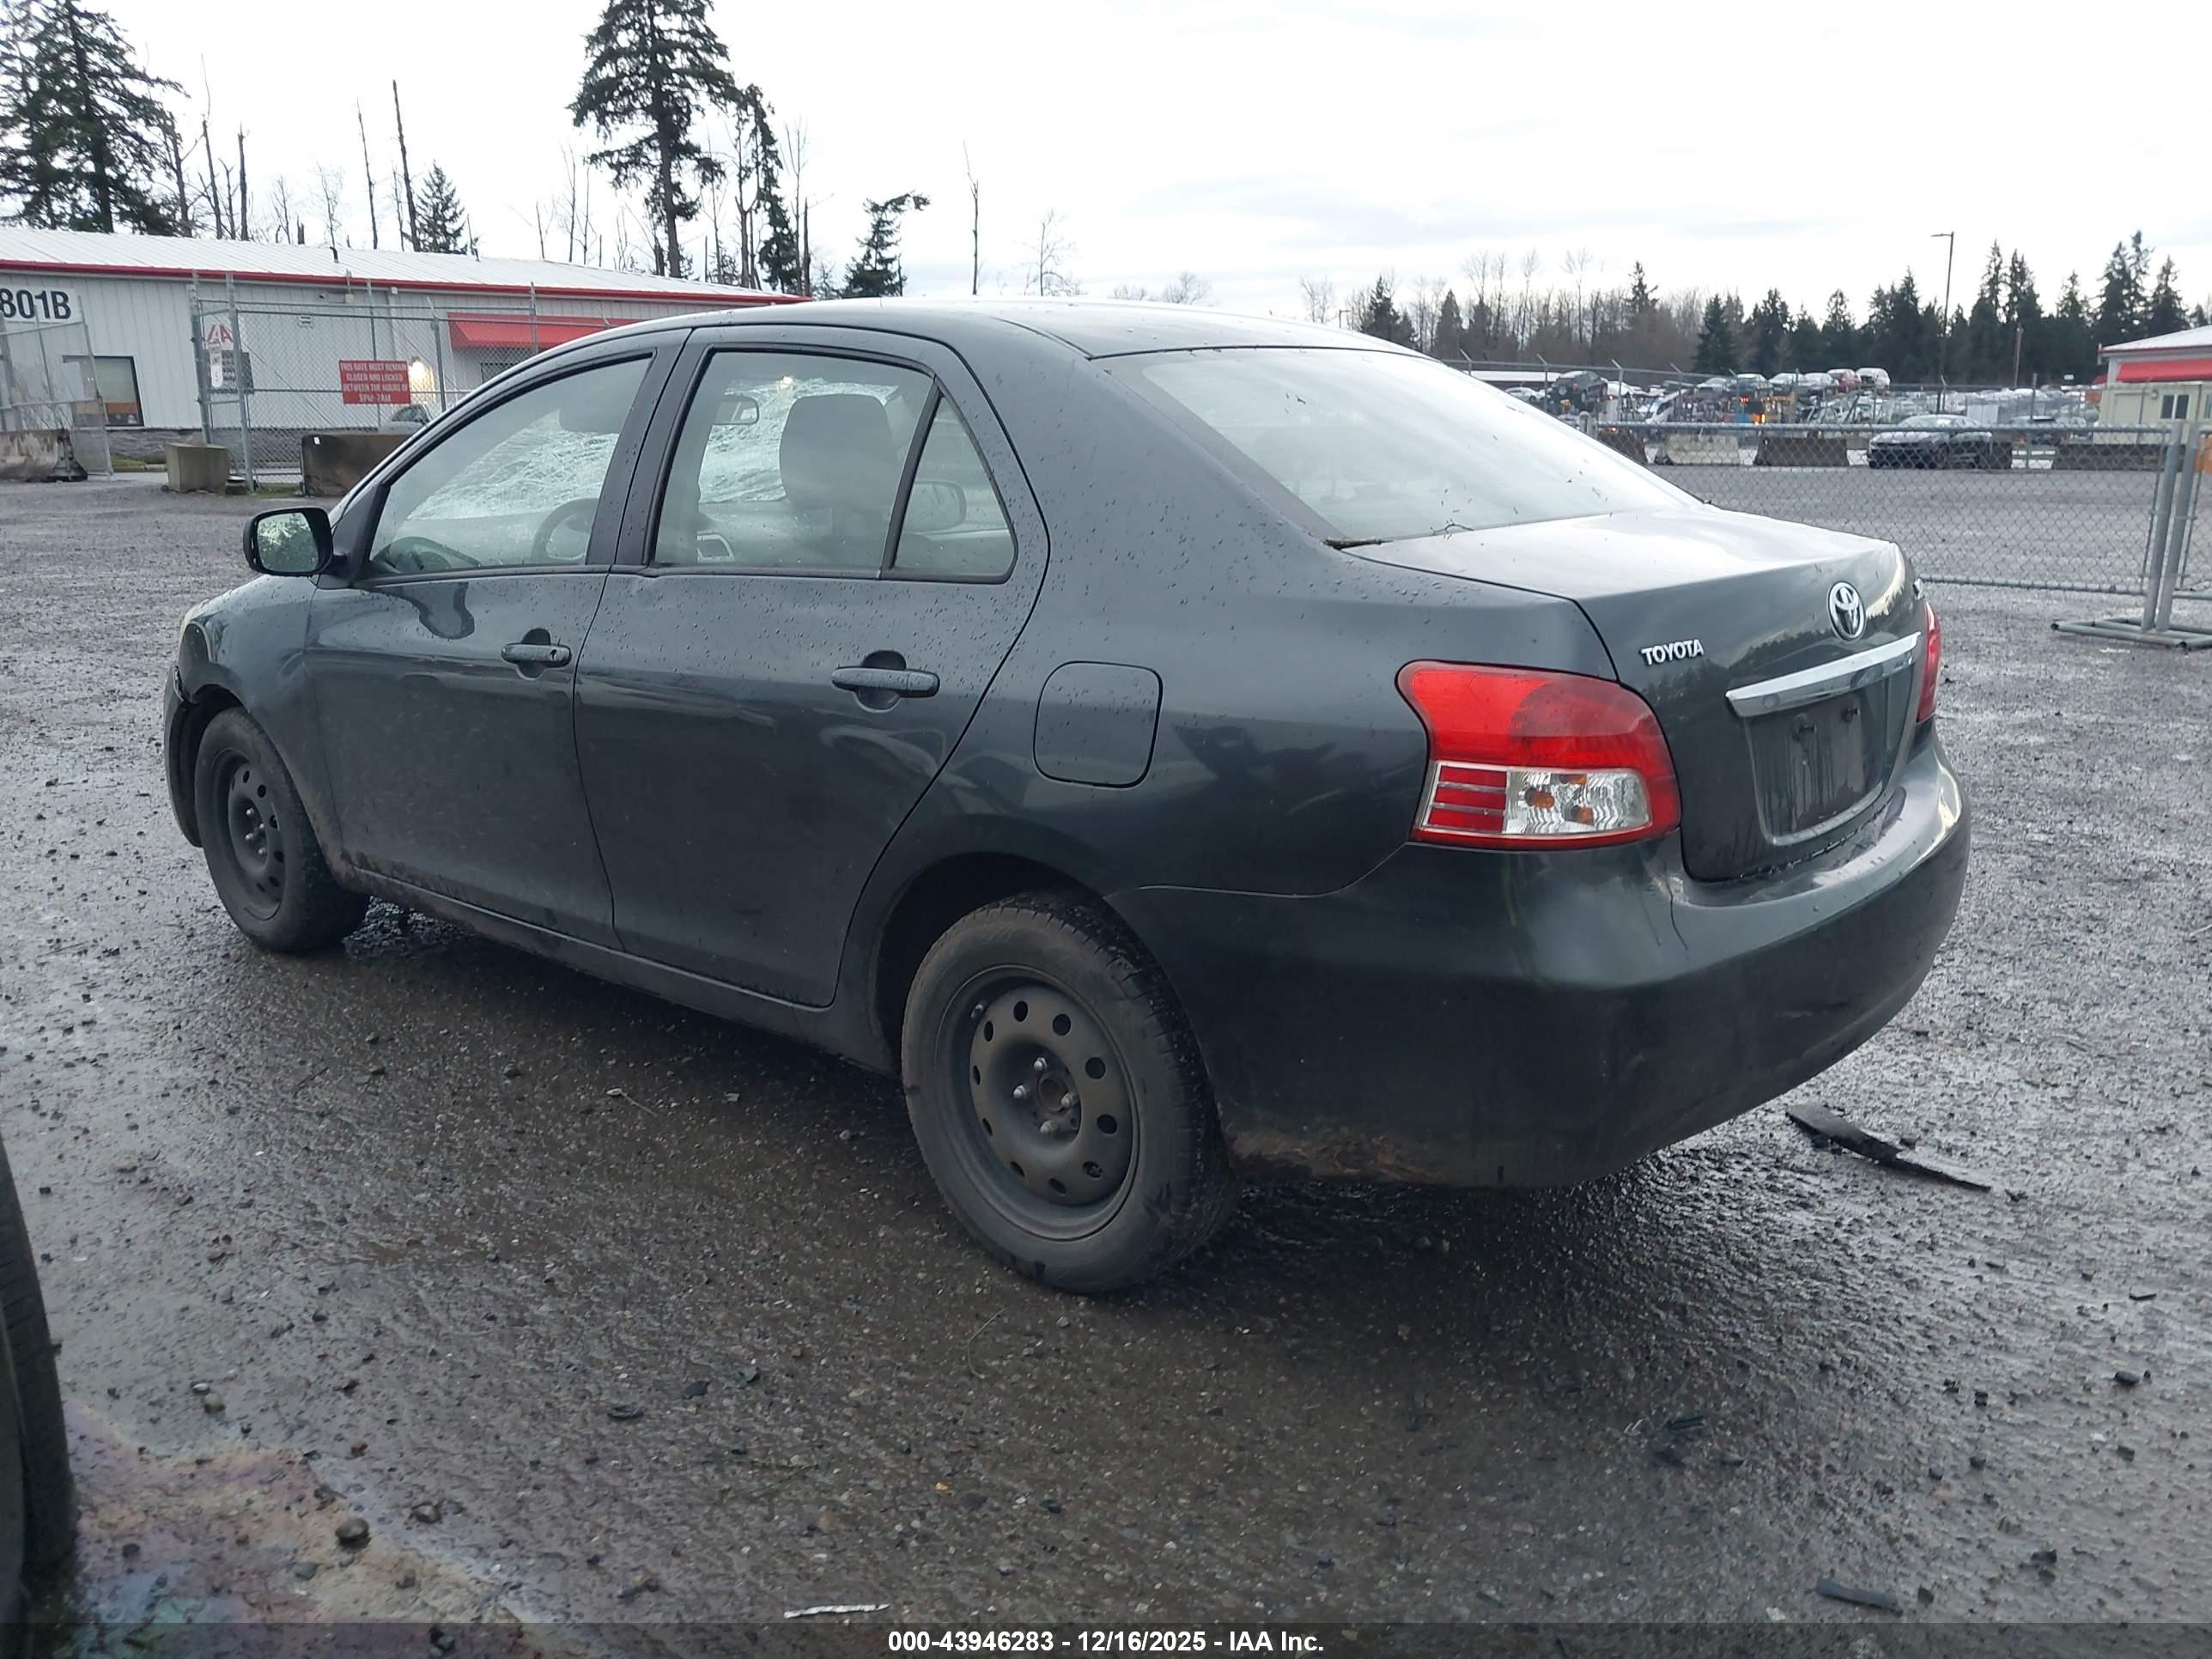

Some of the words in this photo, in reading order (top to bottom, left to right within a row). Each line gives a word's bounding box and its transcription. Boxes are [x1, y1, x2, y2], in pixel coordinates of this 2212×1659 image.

[340, 362, 353, 371] THIS
[354, 362, 368, 371] GATE
[368, 362, 384, 371] MUST
[385, 362, 407, 371] REMAIN
[346, 373, 368, 381] CLOSED
[369, 373, 380, 381] AND
[381, 373, 404, 382] LOCKED
[343, 383, 370, 392] BETWEEN
[370, 383, 380, 392] THE
[381, 383, 401, 392] HOURS
[401, 383, 408, 392] OF
[1641, 638, 1705, 665] TOYOTA
